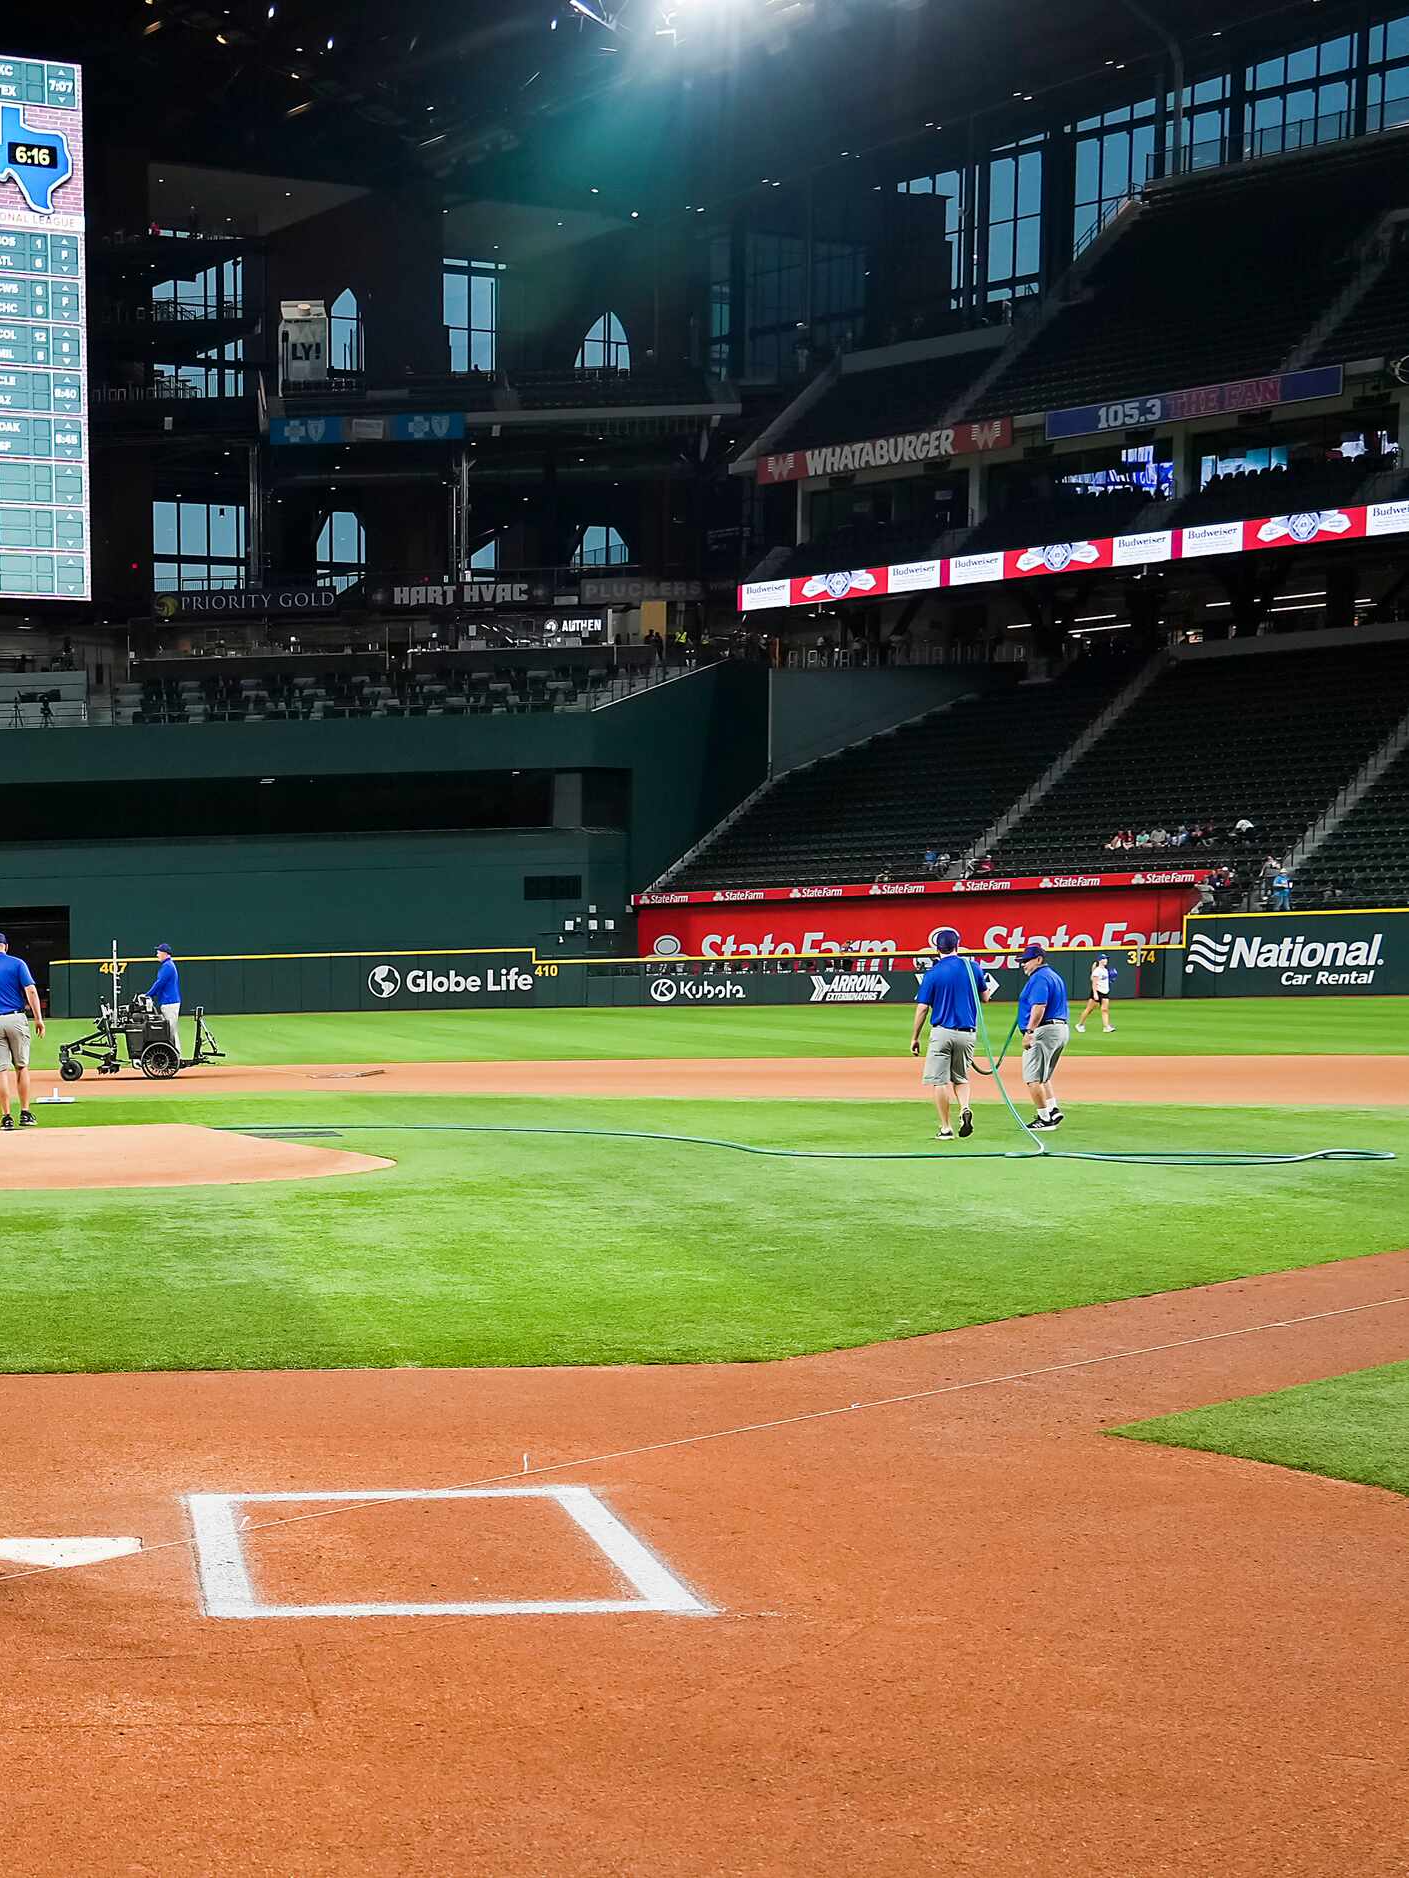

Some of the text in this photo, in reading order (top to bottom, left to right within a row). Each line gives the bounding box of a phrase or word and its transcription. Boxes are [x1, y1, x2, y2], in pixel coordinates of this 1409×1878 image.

[15, 146, 50, 166] 6:16
[33, 212, 75, 227] LEAGUE
[292, 343, 321, 360] LY!
[1097, 399, 1161, 429] 105.3
[806, 429, 956, 476] WHATABURGER
[1188, 526, 1238, 540] Budweiser
[1118, 535, 1166, 548] Budweiser
[892, 564, 935, 577] Budweiser
[955, 556, 999, 569] Budweiser
[394, 583, 529, 606] HART HVAC
[746, 583, 786, 595] Budweiser
[181, 591, 335, 611] PRIORITY GOLD
[535, 965, 558, 977] 410
[1280, 969, 1375, 986] Car Rental
[406, 967, 533, 993] Globe Life
[829, 975, 878, 991] ARROW
[680, 980, 745, 999] Kubota
[826, 991, 878, 1001] EXTERMINATORS
